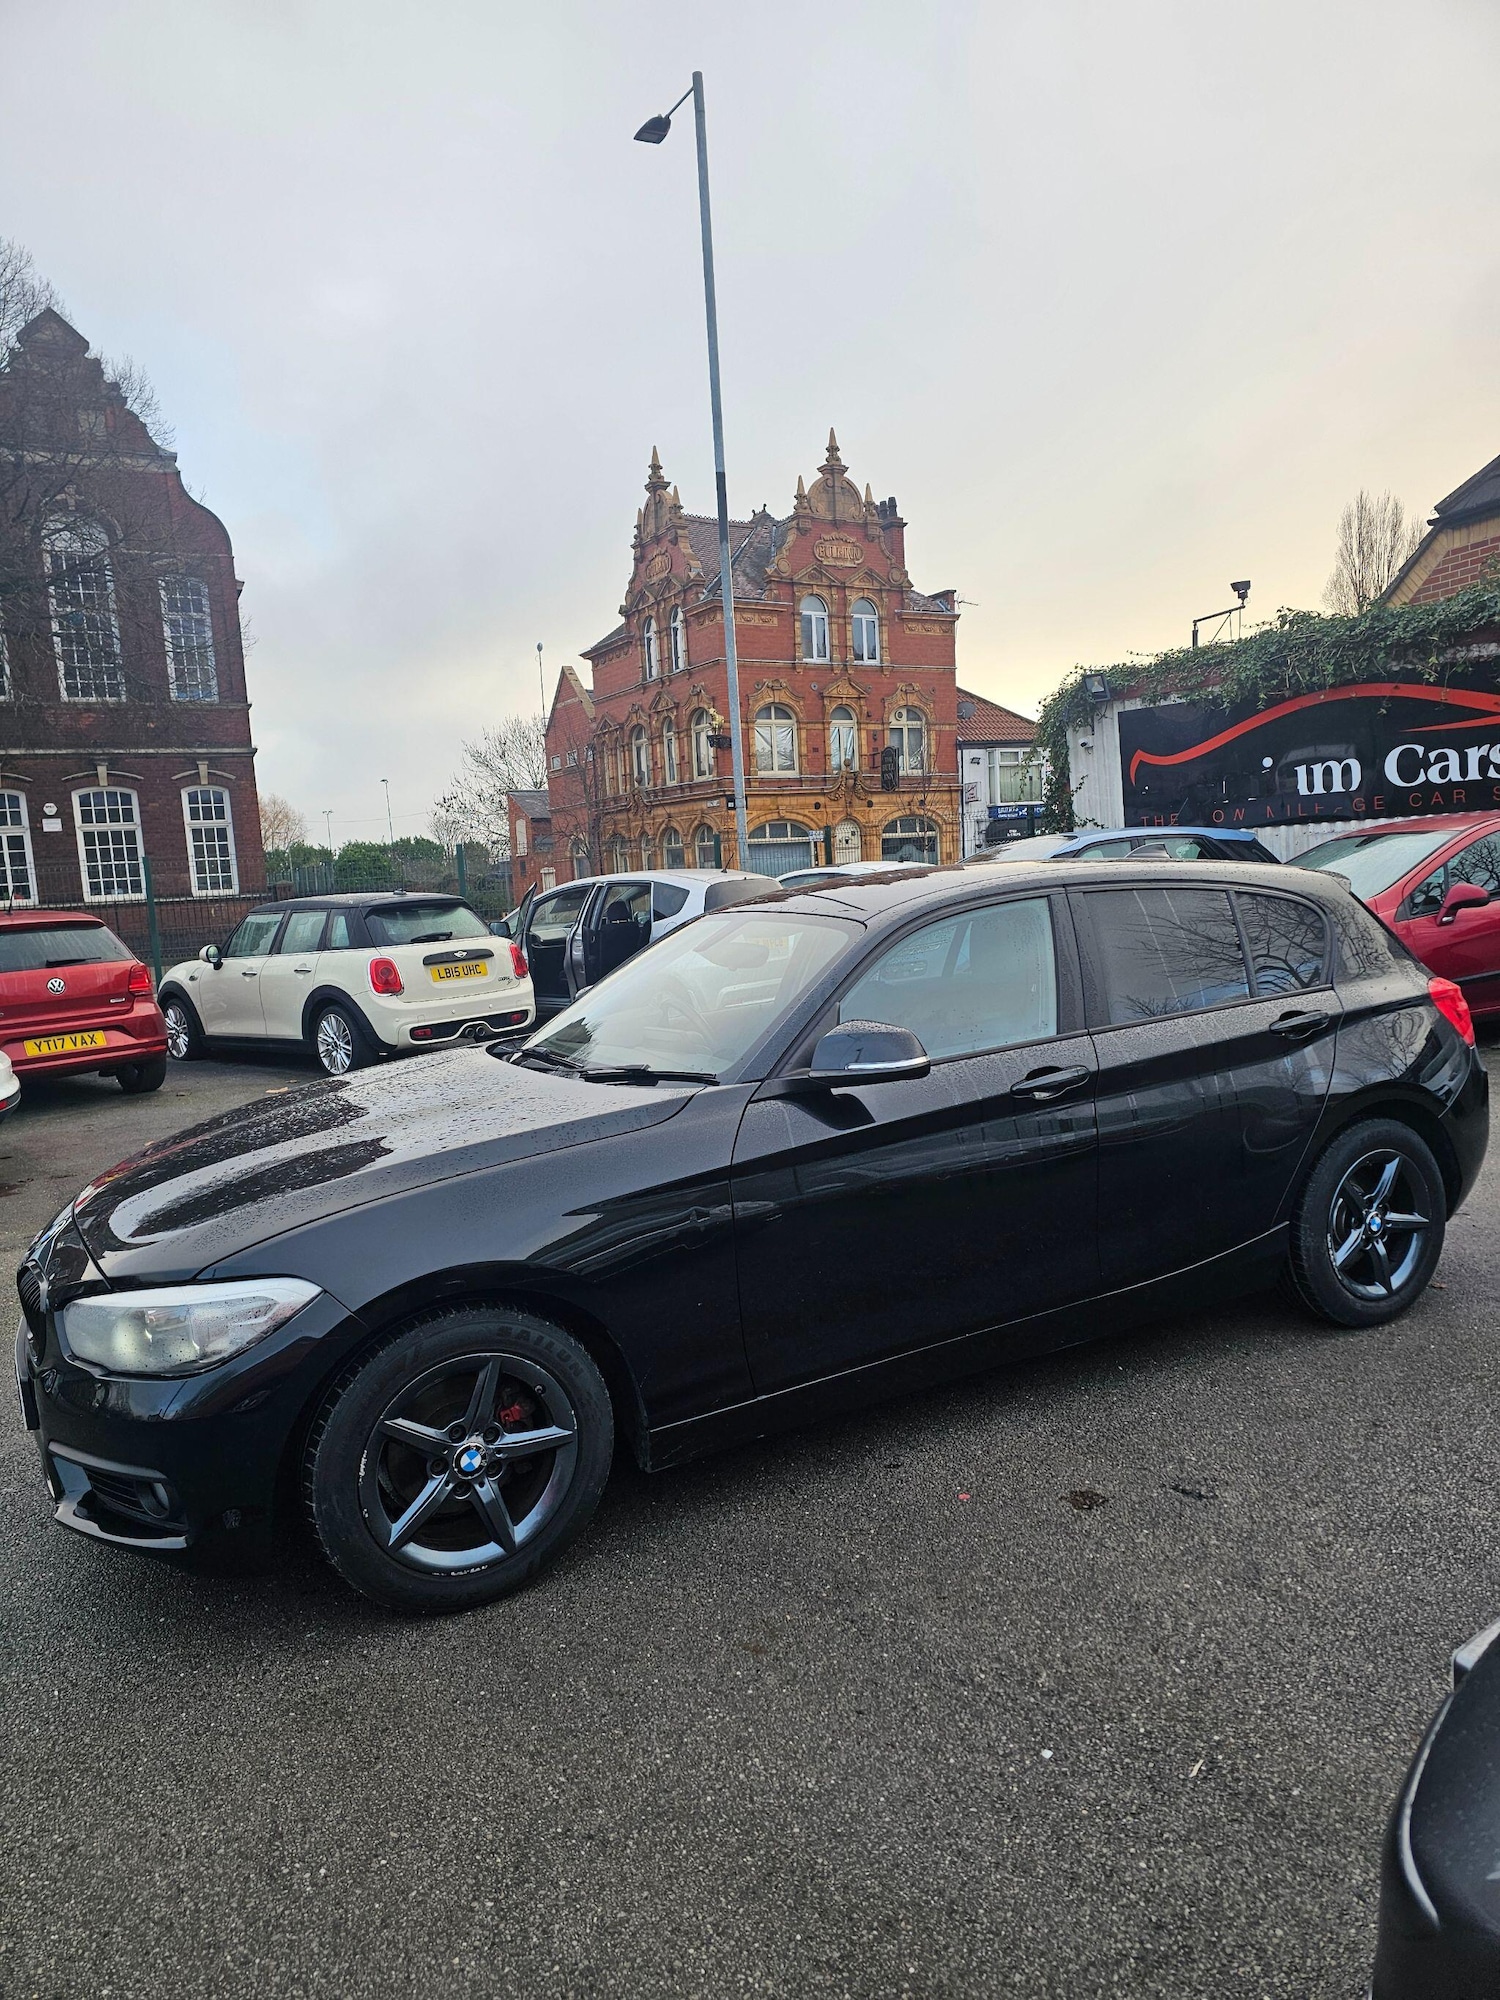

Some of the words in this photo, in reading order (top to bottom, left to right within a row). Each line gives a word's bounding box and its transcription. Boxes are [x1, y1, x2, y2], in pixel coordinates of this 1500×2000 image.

[1409, 788, 1466, 807] CAR
[437, 966, 461, 979] LB15
[462, 964, 482, 976] UHC
[33, 1037, 65, 1053] YT17
[69, 1034, 98, 1048] VAX
